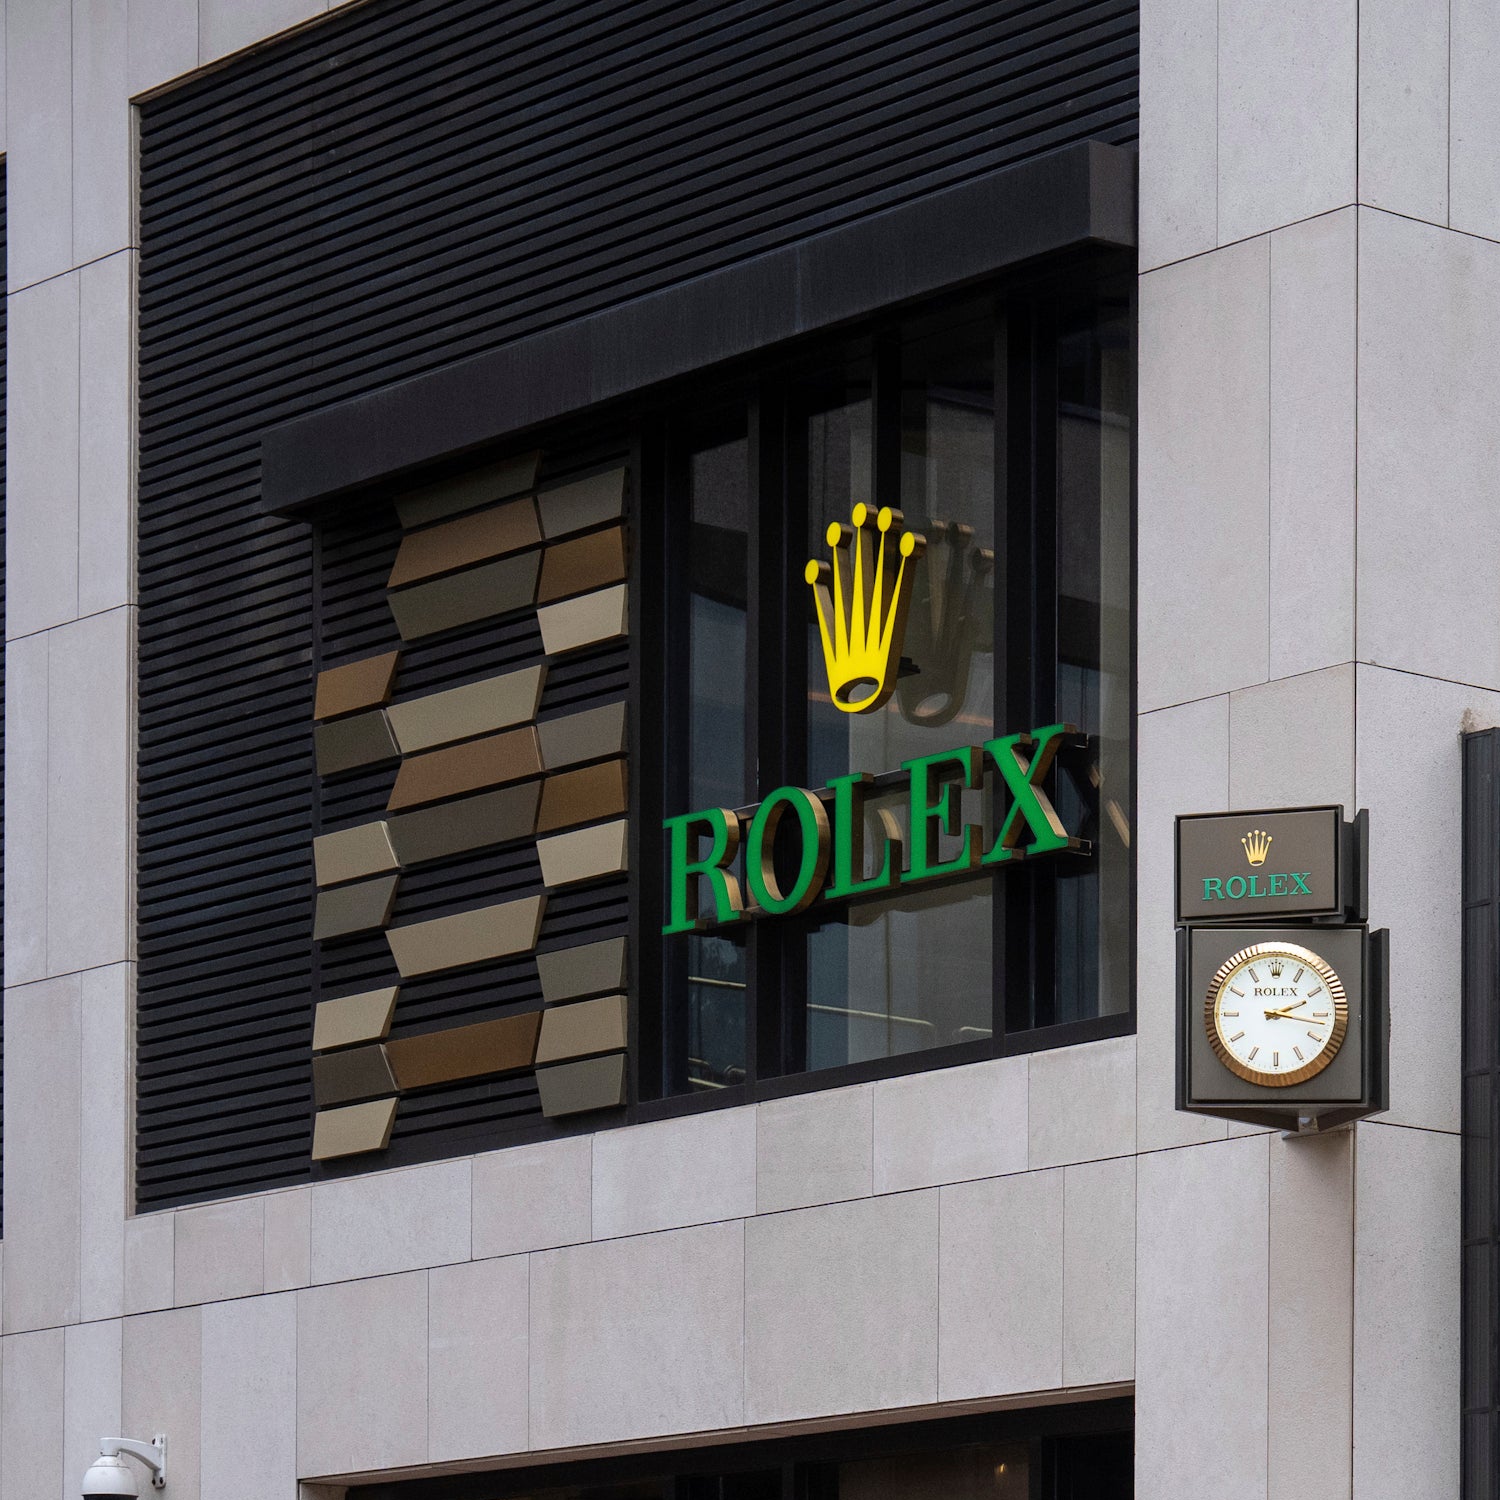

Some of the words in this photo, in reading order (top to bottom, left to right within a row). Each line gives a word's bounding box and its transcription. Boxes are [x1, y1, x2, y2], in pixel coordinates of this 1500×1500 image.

[662, 723, 1075, 936] ROLEX
[1202, 871, 1312, 901] ROLEX
[1254, 986, 1299, 997] ROLEX
